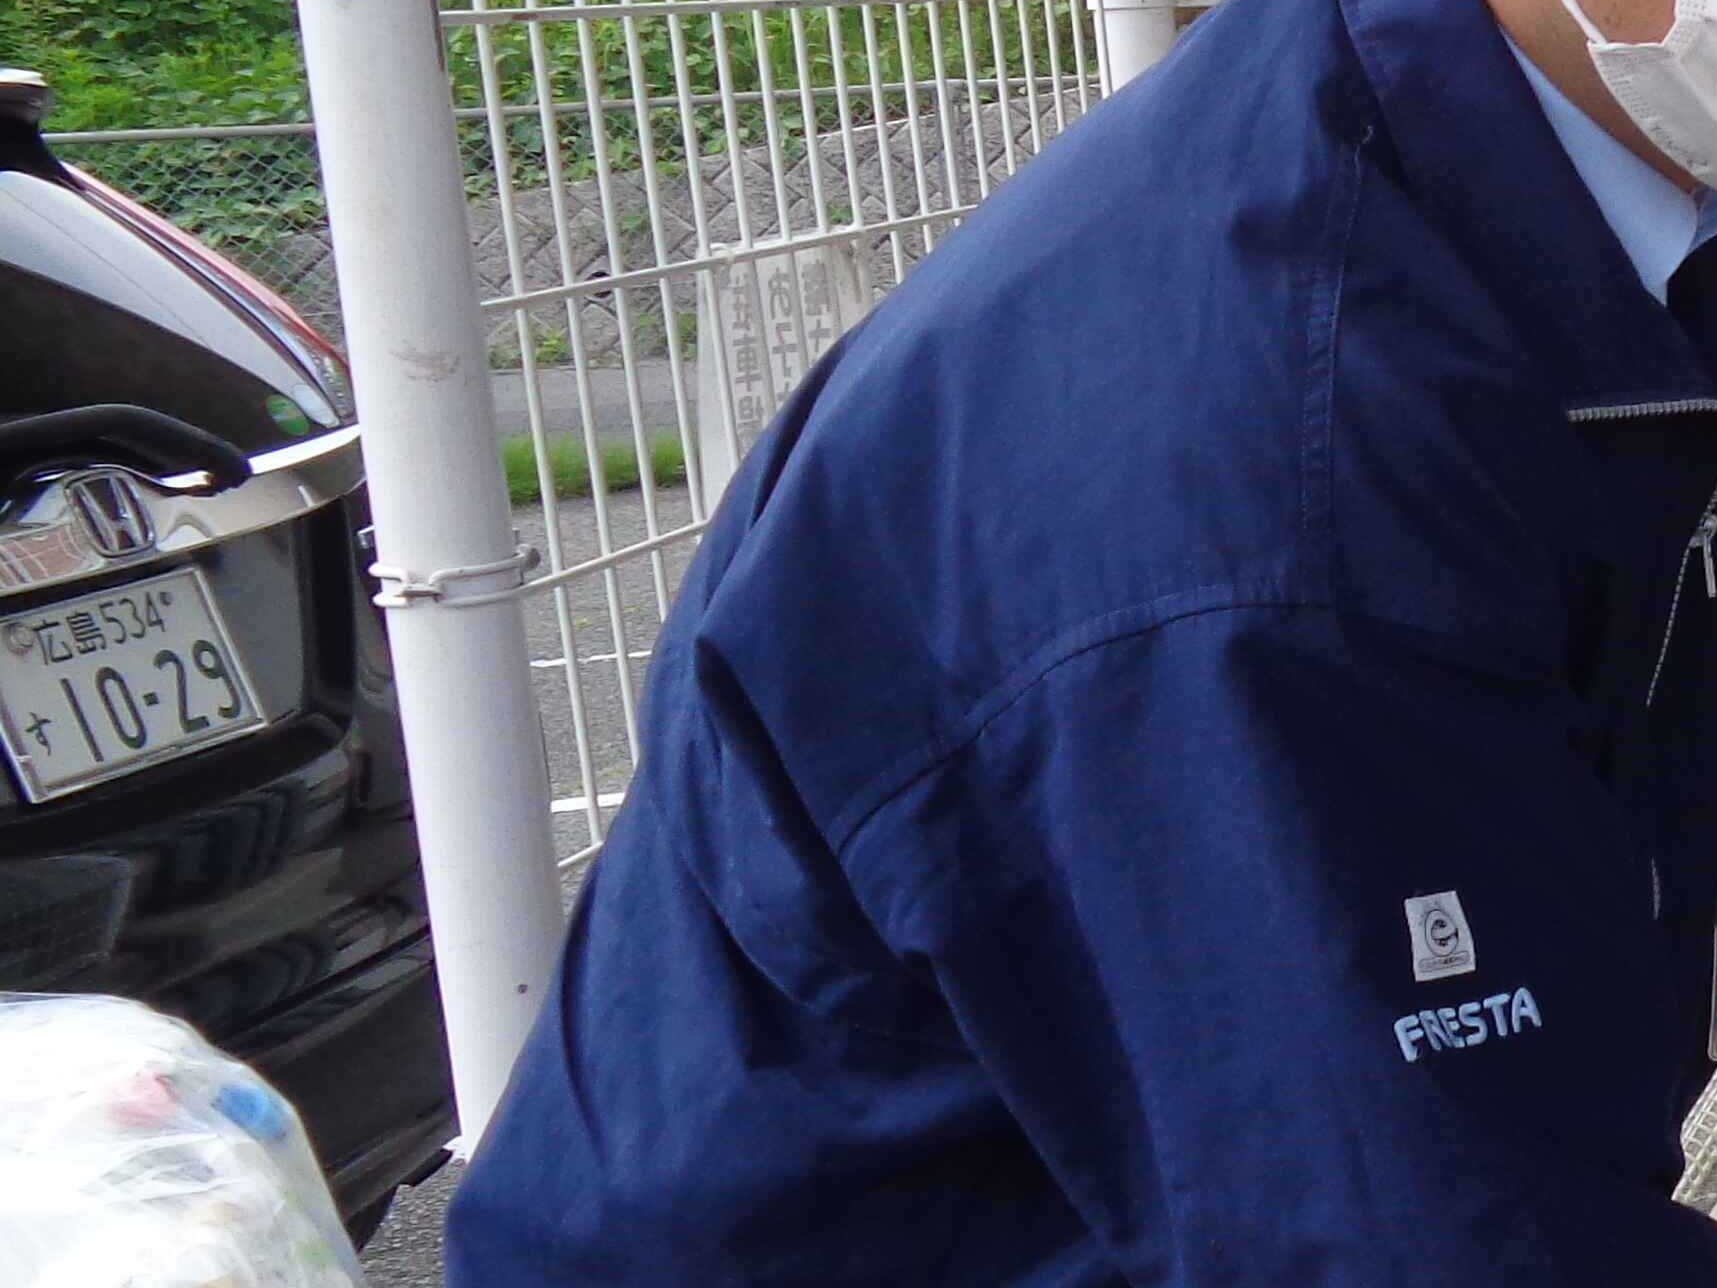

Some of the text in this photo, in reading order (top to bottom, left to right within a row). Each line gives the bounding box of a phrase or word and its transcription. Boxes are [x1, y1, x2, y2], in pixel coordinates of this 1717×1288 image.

[25, 639, 242, 763] す 10-29
[1393, 987, 1542, 1063] FRESTA
